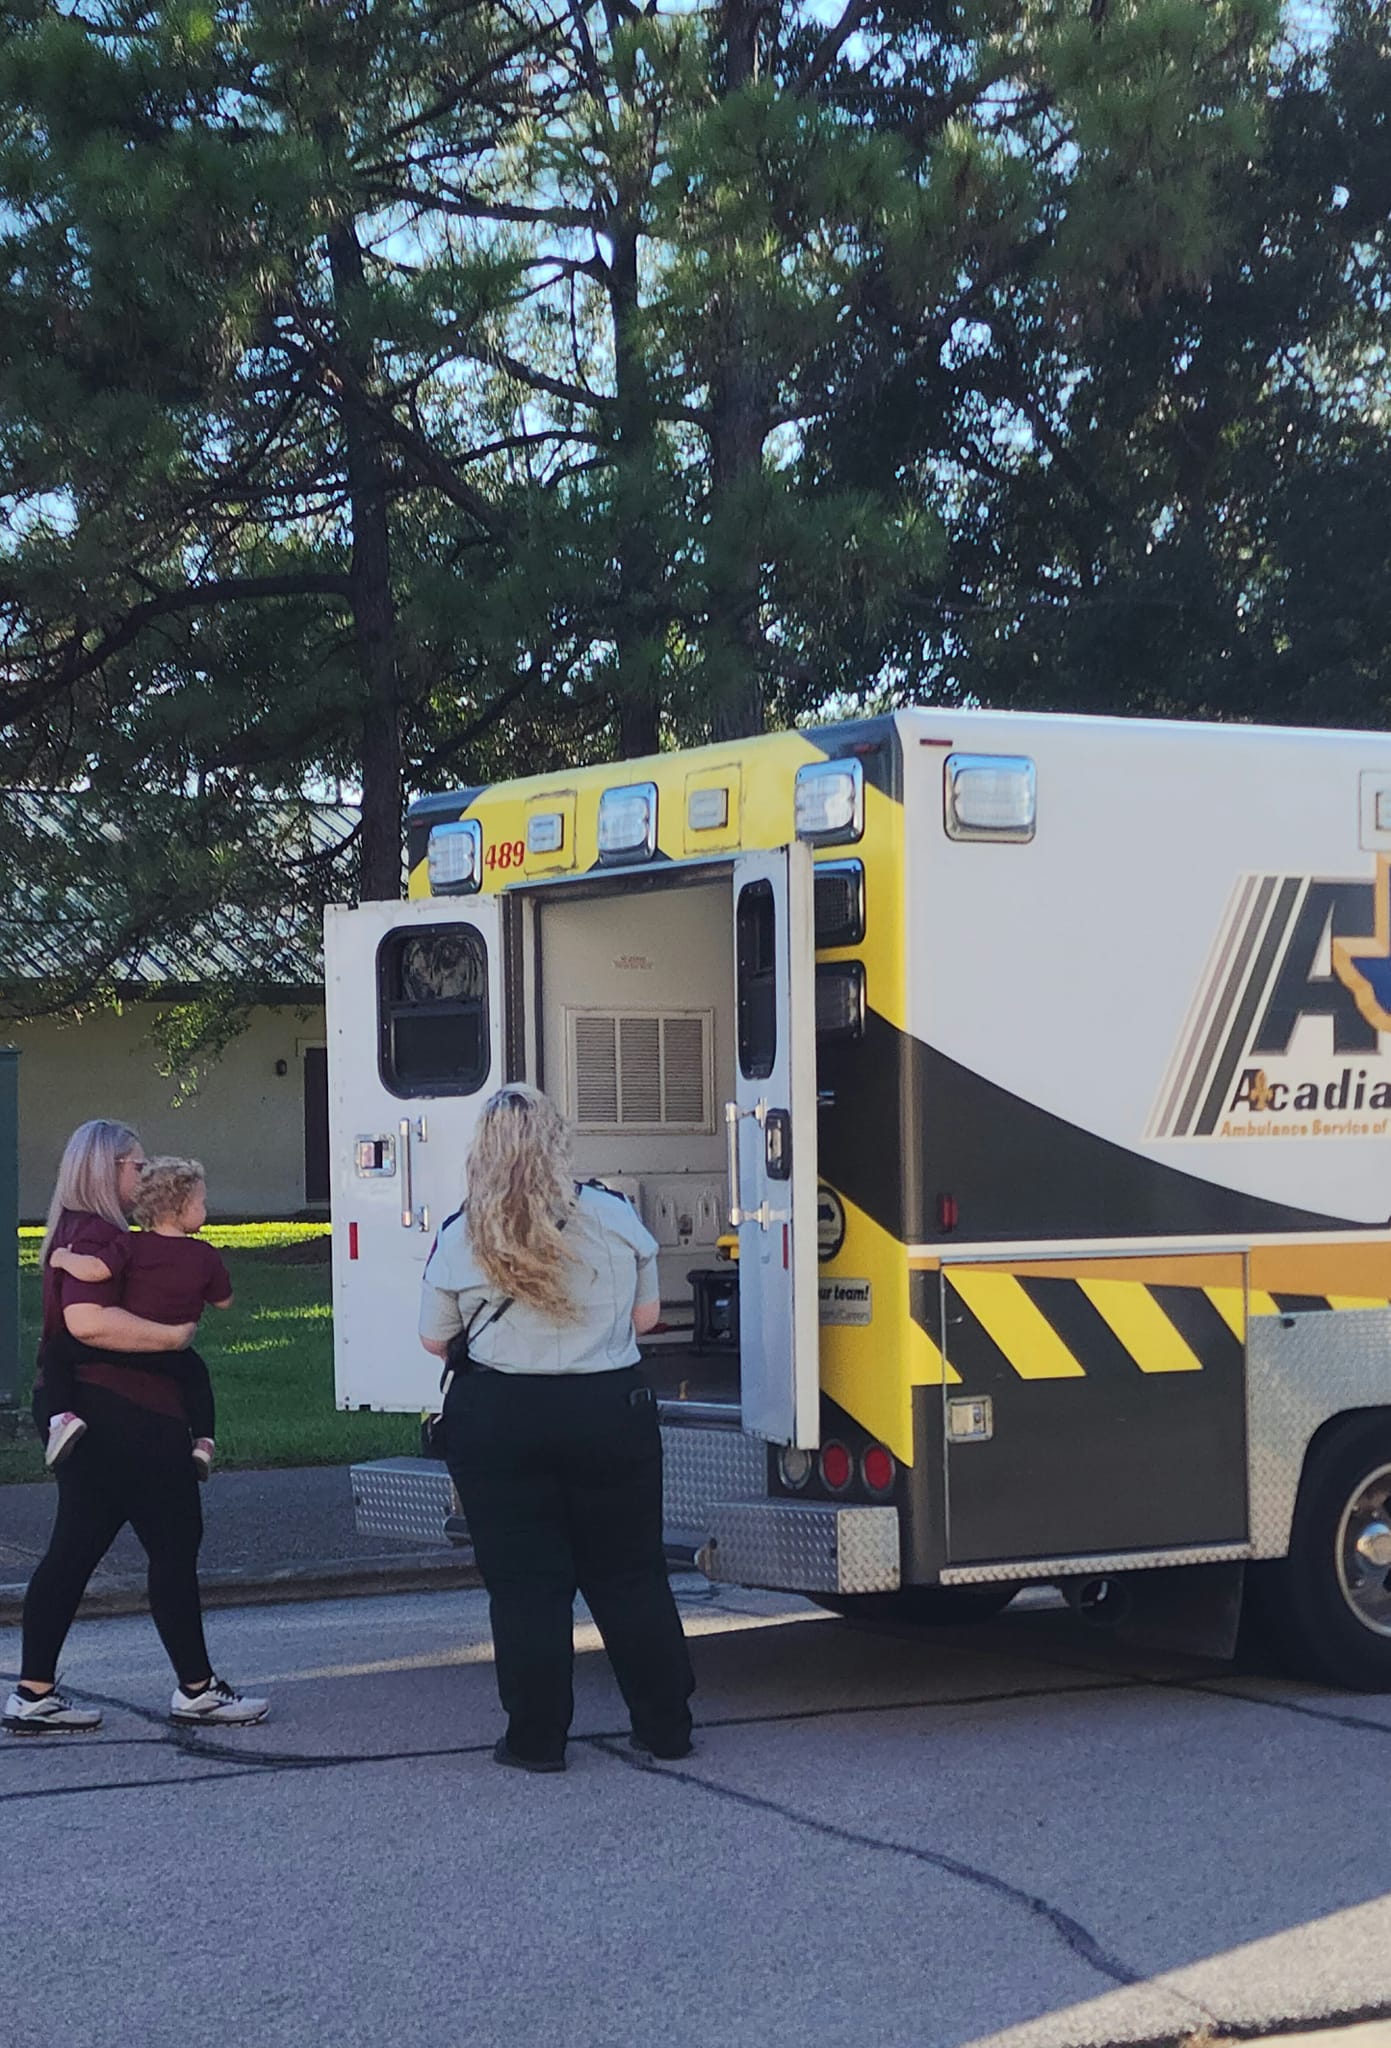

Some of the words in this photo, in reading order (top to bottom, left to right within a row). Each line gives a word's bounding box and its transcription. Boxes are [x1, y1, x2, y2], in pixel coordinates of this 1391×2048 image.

[485, 840, 525, 871] 489
[1221, 1120, 1308, 1137] Ambulance
[1312, 1119, 1369, 1136] Service
[1373, 1119, 1388, 1134] of
[818, 1288, 832, 1300] ur
[834, 1285, 869, 1301] team!
